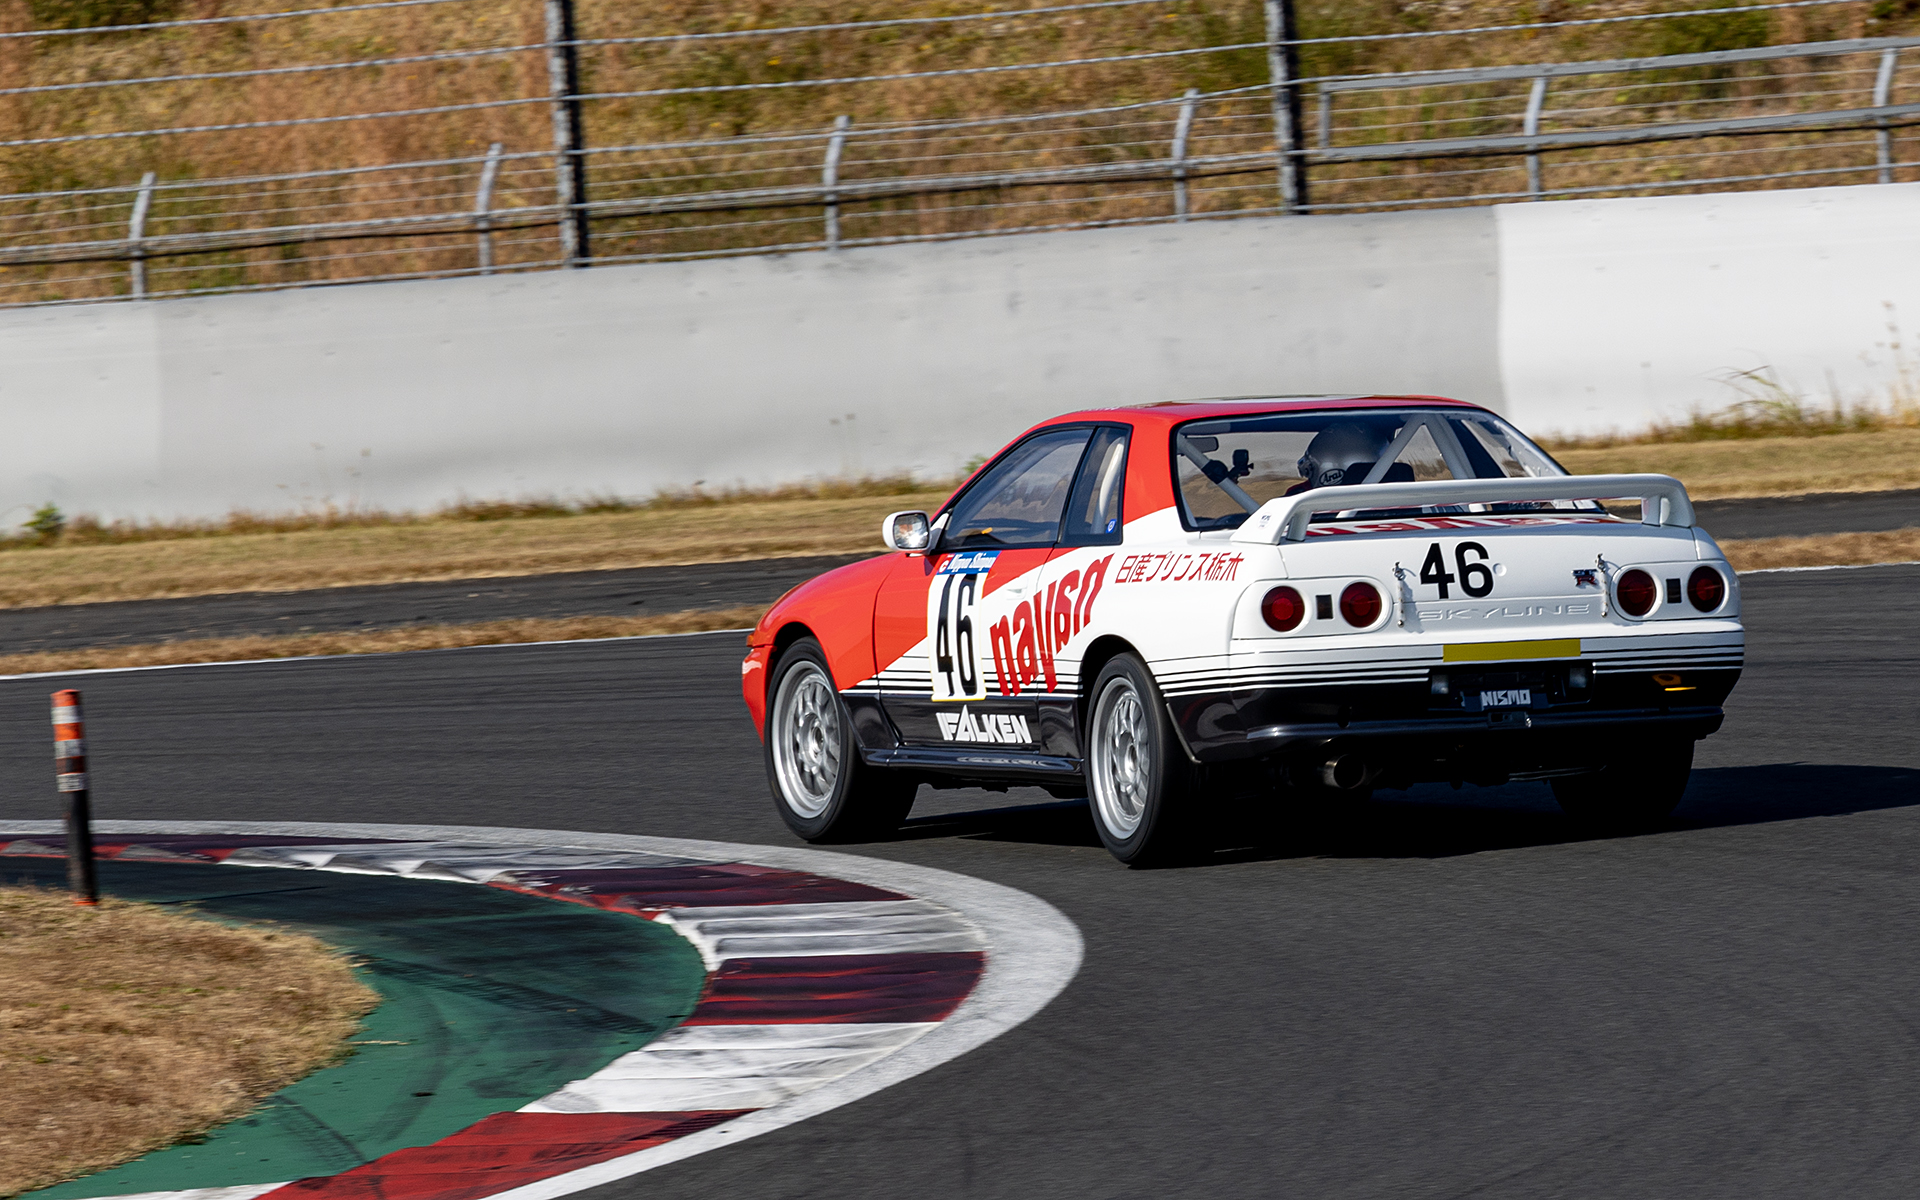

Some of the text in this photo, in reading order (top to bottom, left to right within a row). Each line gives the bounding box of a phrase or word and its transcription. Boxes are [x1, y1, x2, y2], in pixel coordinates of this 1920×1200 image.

[1323, 469, 1342, 484] Arai
[1115, 551, 1245, 584] 日産プリンス栃木
[1420, 541, 1494, 599] 46
[1417, 603, 1590, 622] SKYLINE
[936, 573, 978, 697] 46
[1480, 689, 1531, 710] NISMO
[935, 704, 1033, 743] FALKEN
